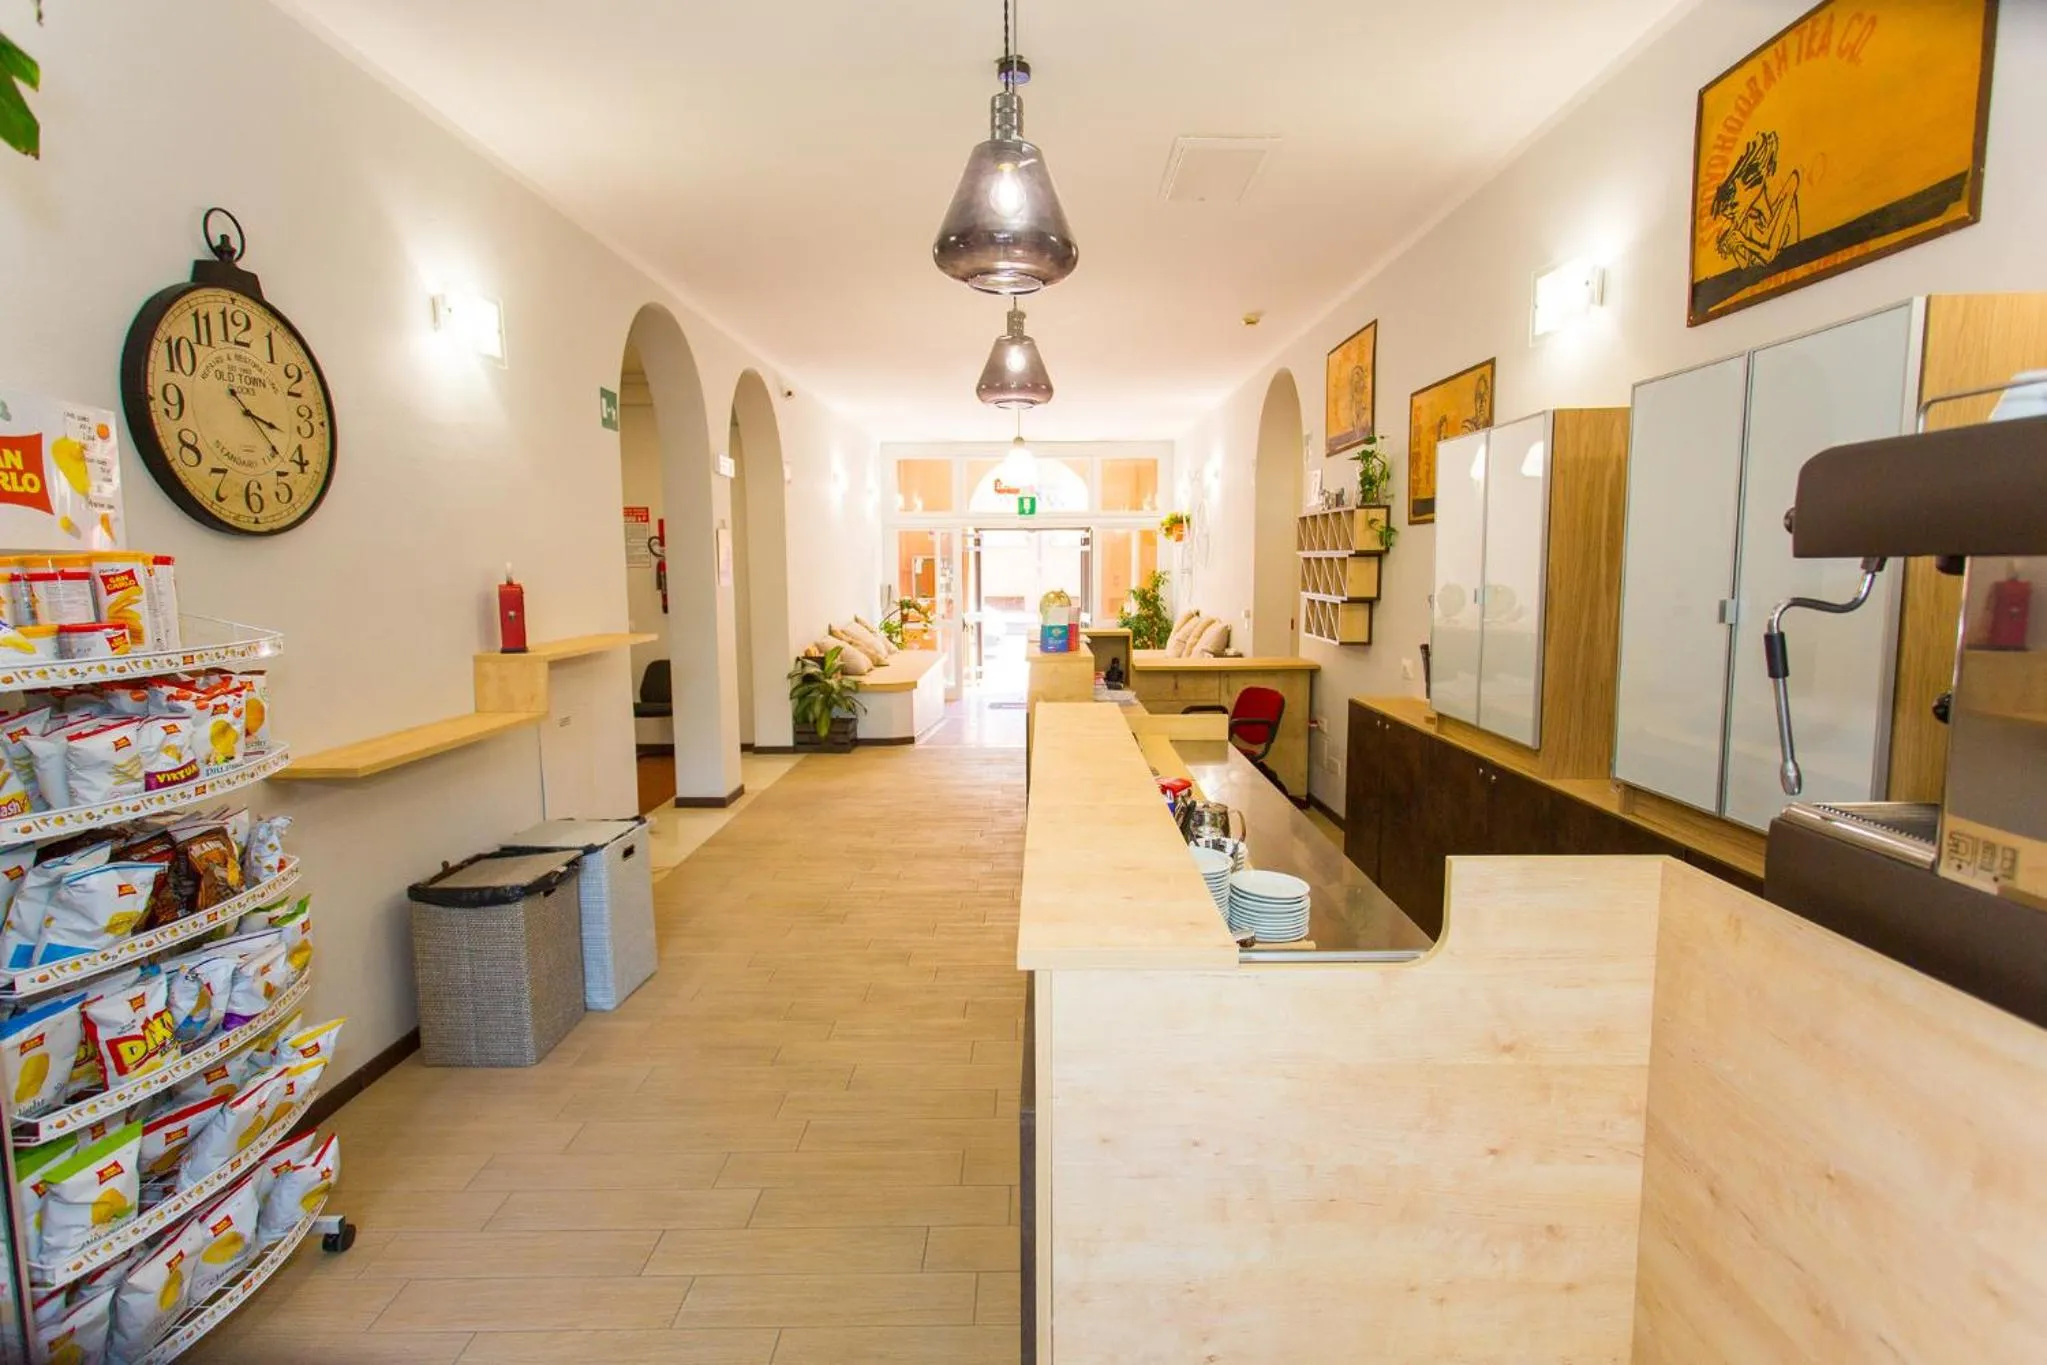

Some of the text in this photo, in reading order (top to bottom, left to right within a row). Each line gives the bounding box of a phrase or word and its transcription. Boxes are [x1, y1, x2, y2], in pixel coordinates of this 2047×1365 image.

[192, 308, 216, 348] 11
[220, 306, 252, 348] 12
[165, 335, 197, 377] 10
[265, 329, 278, 365] 1
[215, 369, 235, 382] OLD
[238, 373, 266, 388] TOWN
[284, 363, 303, 398] 2
[162, 383, 184, 421] 9
[296, 404, 314, 439] 3
[177, 428, 202, 467] 8
[289, 443, 309, 474] 4
[0, 471, 41, 494] RLO
[209, 467, 228, 503] 7
[244, 479, 264, 514] 6
[275, 470, 293, 504] 5
